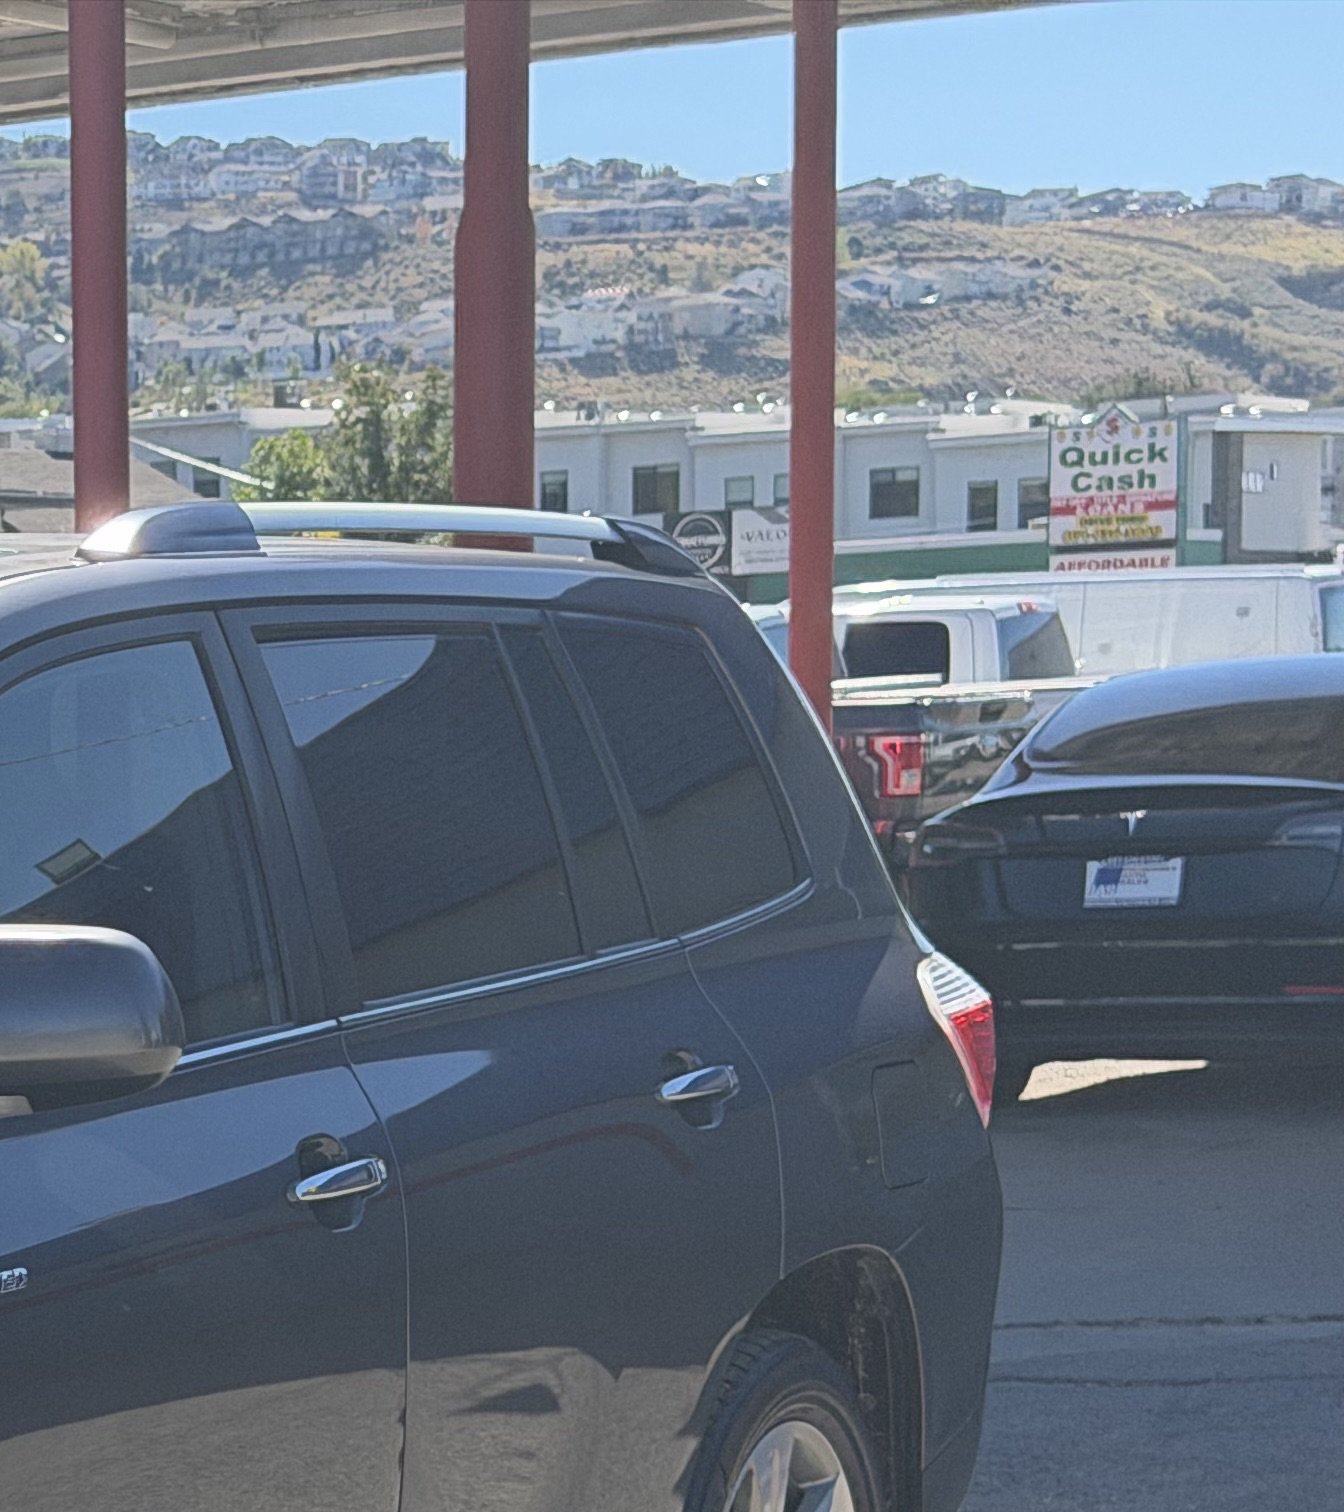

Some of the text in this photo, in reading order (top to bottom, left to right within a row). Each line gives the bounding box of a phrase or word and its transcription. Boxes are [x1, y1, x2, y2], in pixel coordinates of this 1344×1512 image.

[1059, 442, 1168, 468] Quick
[1071, 468, 1156, 493] Cash
[1055, 555, 1170, 572] AFFORDABLE
